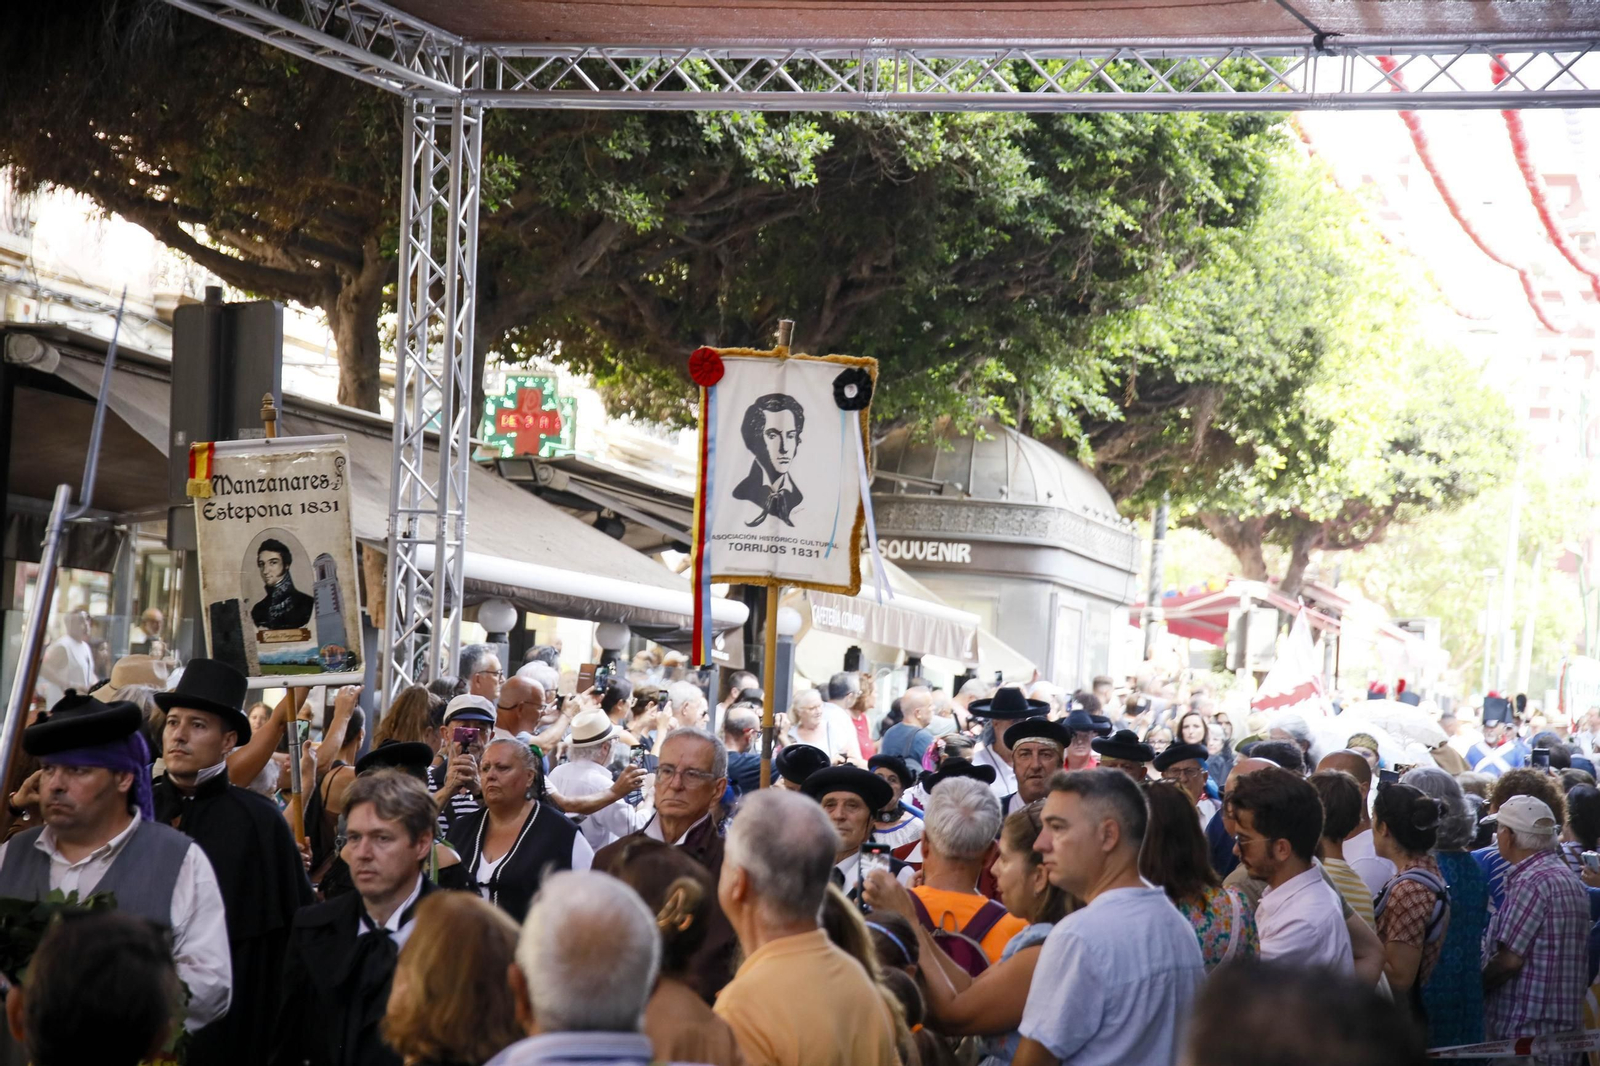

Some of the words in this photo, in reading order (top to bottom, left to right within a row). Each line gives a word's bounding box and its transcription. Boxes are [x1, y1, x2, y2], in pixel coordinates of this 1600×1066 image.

[211, 473, 330, 497] Manzanares
[202, 502, 292, 523] Estepona
[300, 500, 339, 515] 1831
[728, 542, 787, 554] TORRIJOS
[791, 547, 820, 559] 1831
[877, 539, 972, 563] SOUVENIR
